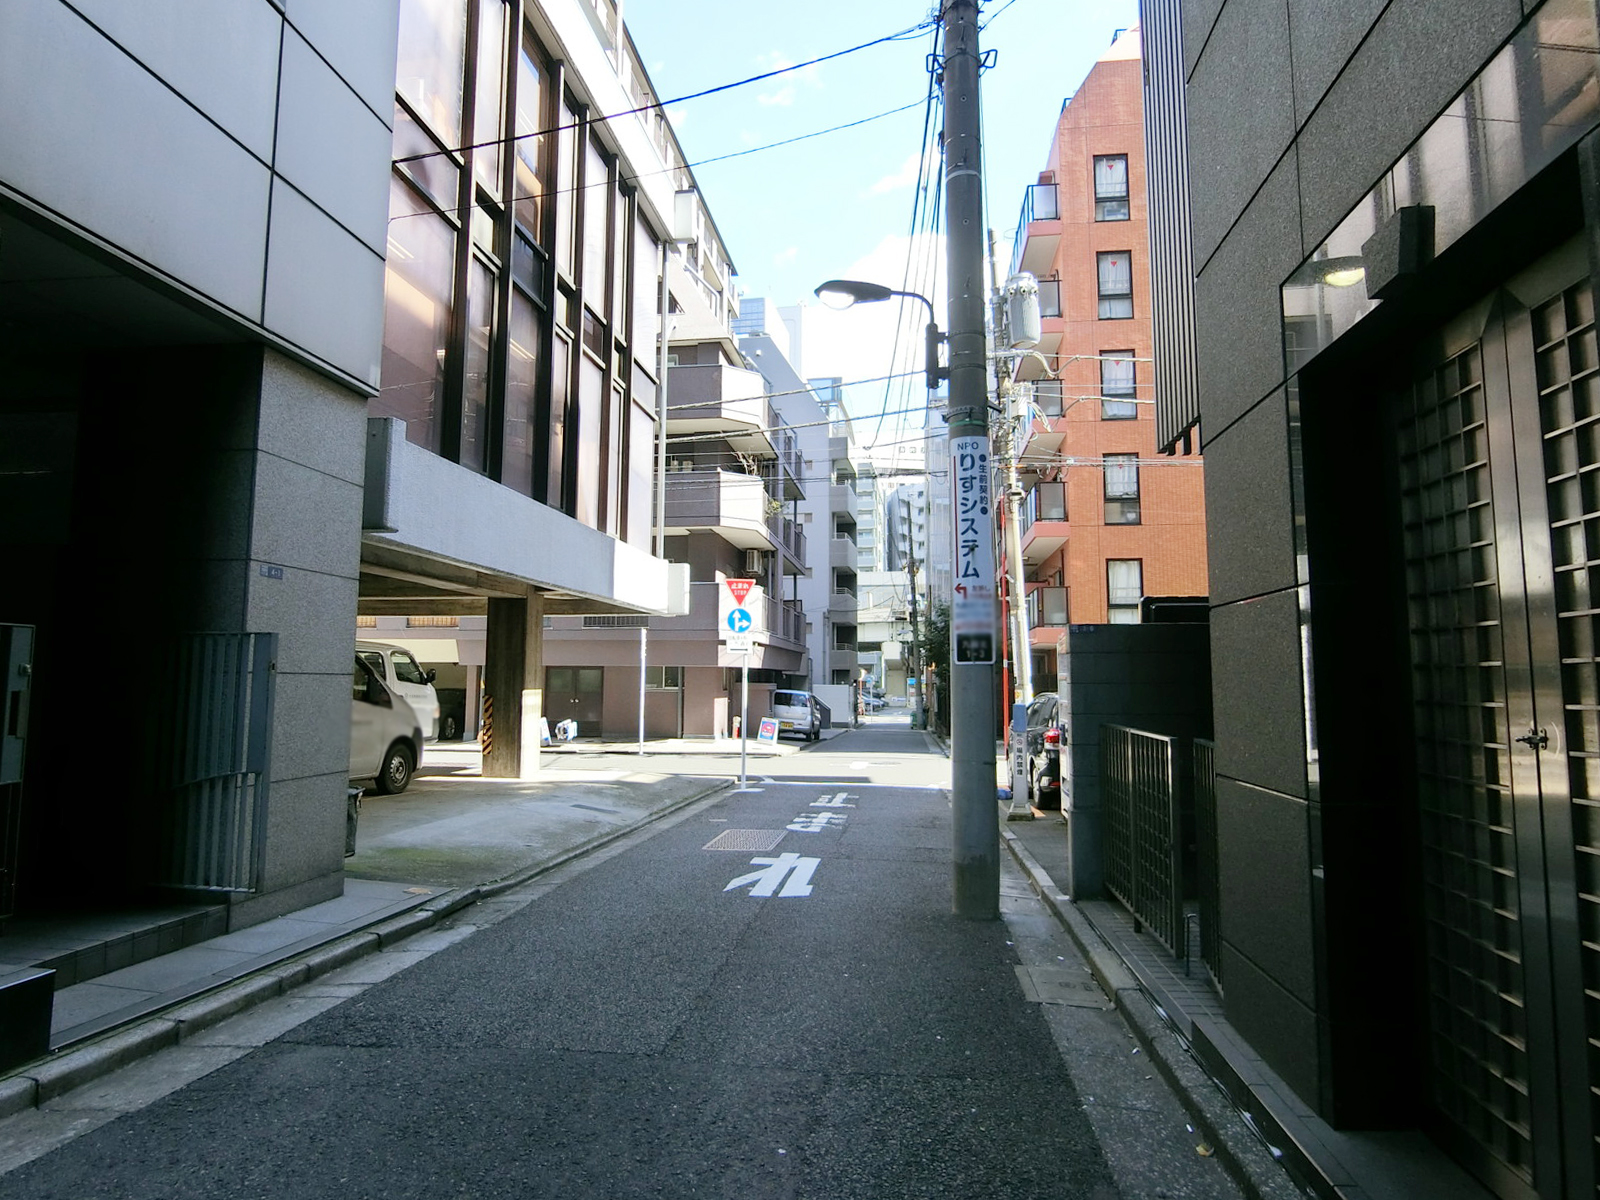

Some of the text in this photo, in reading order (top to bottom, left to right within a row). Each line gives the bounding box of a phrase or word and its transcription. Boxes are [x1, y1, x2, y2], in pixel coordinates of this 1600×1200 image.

[957, 441, 979, 451] NPO
[959, 453, 980, 579] りすシステム
[979, 464, 989, 505] 生前契約
[722, 792, 860, 898] 止まれ
